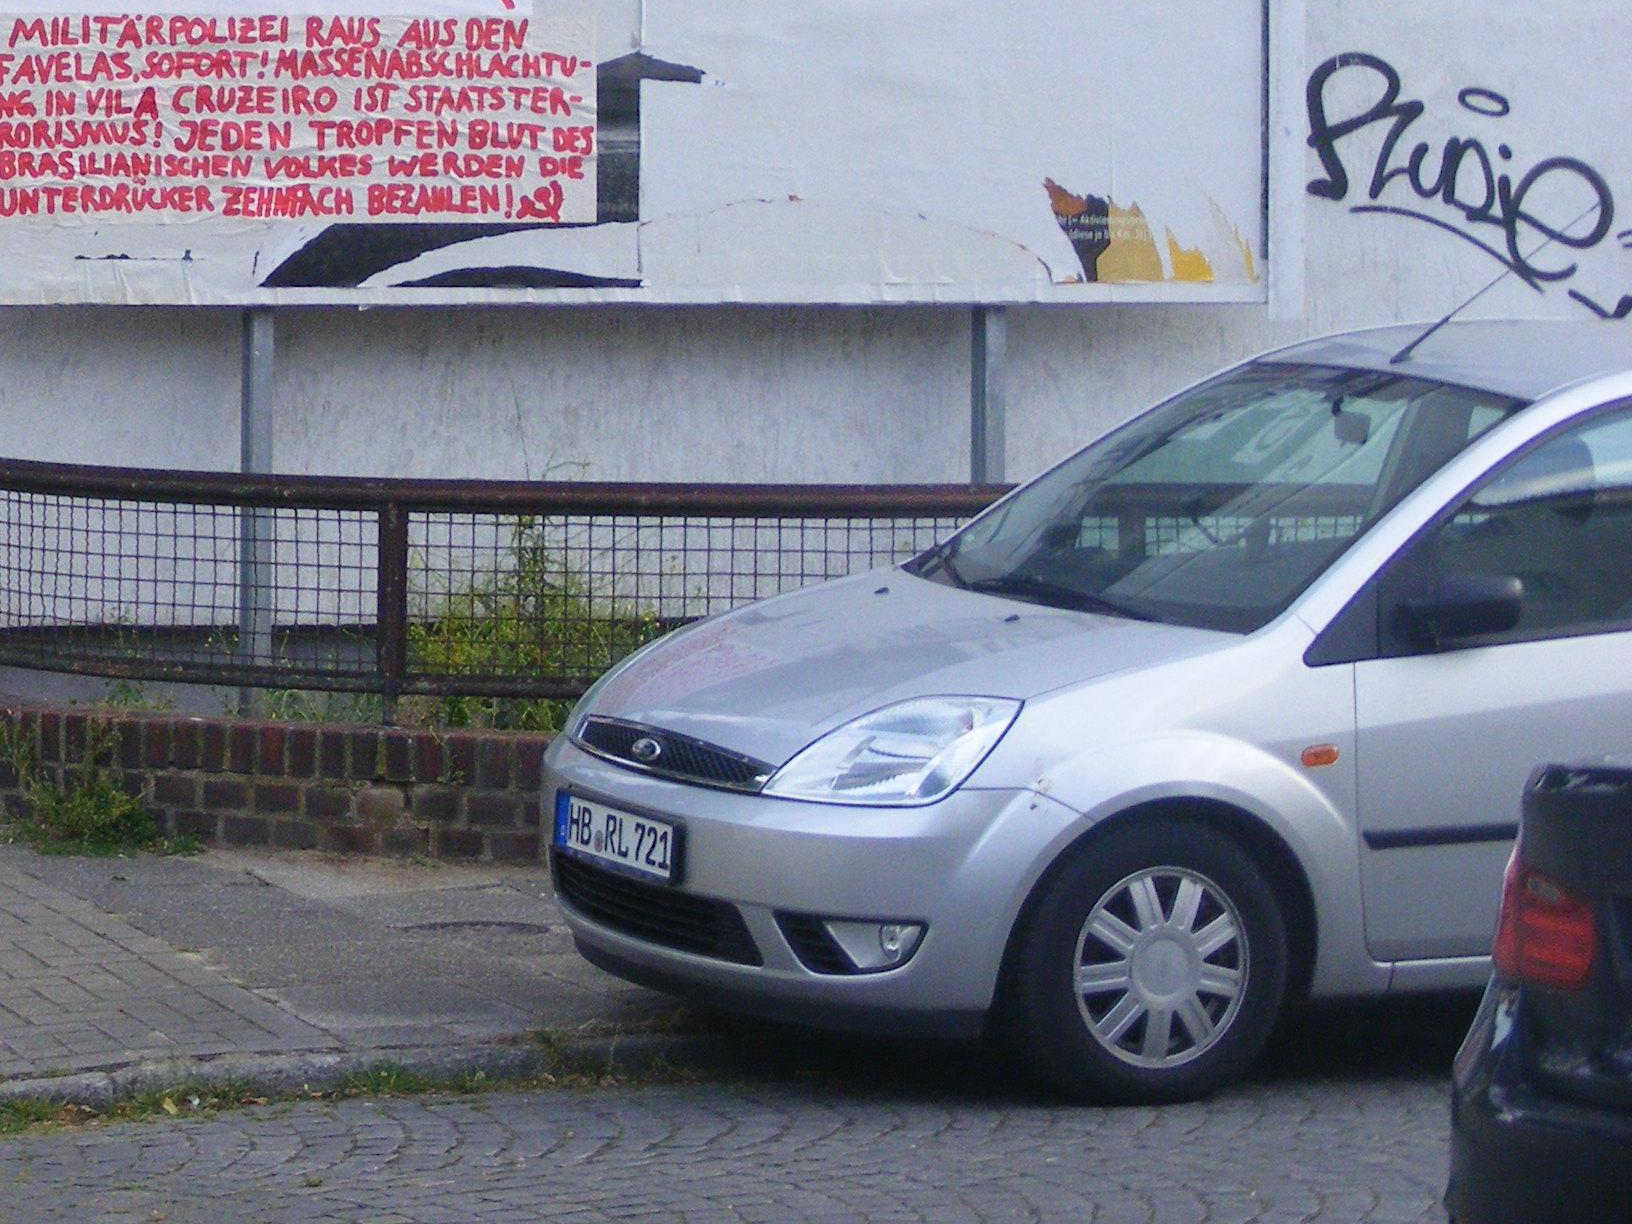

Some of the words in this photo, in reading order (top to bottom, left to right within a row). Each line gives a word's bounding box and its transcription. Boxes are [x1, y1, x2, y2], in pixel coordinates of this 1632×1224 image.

[8, 14, 289, 49] MILITÄRPOLIZEI
[306, 15, 381, 49] RAUS
[396, 17, 458, 50] AUS
[465, 18, 529, 52] DEN
[45, 89, 76, 115] IN
[86, 86, 158, 121] VILA
[171, 84, 338, 116] CRUZEIRO
[354, 82, 400, 113] IST
[173, 118, 292, 152] JEDEN
[308, 118, 458, 150] TROPFEN
[467, 118, 546, 150] BLUT
[551, 125, 594, 156] DES
[264, 153, 372, 179] VOLKES
[388, 151, 525, 179] WERDEN
[538, 154, 585, 179] DIE
[569, 803, 593, 846] HB
[604, 814, 629, 858] RL
[634, 822, 670, 870] 721
